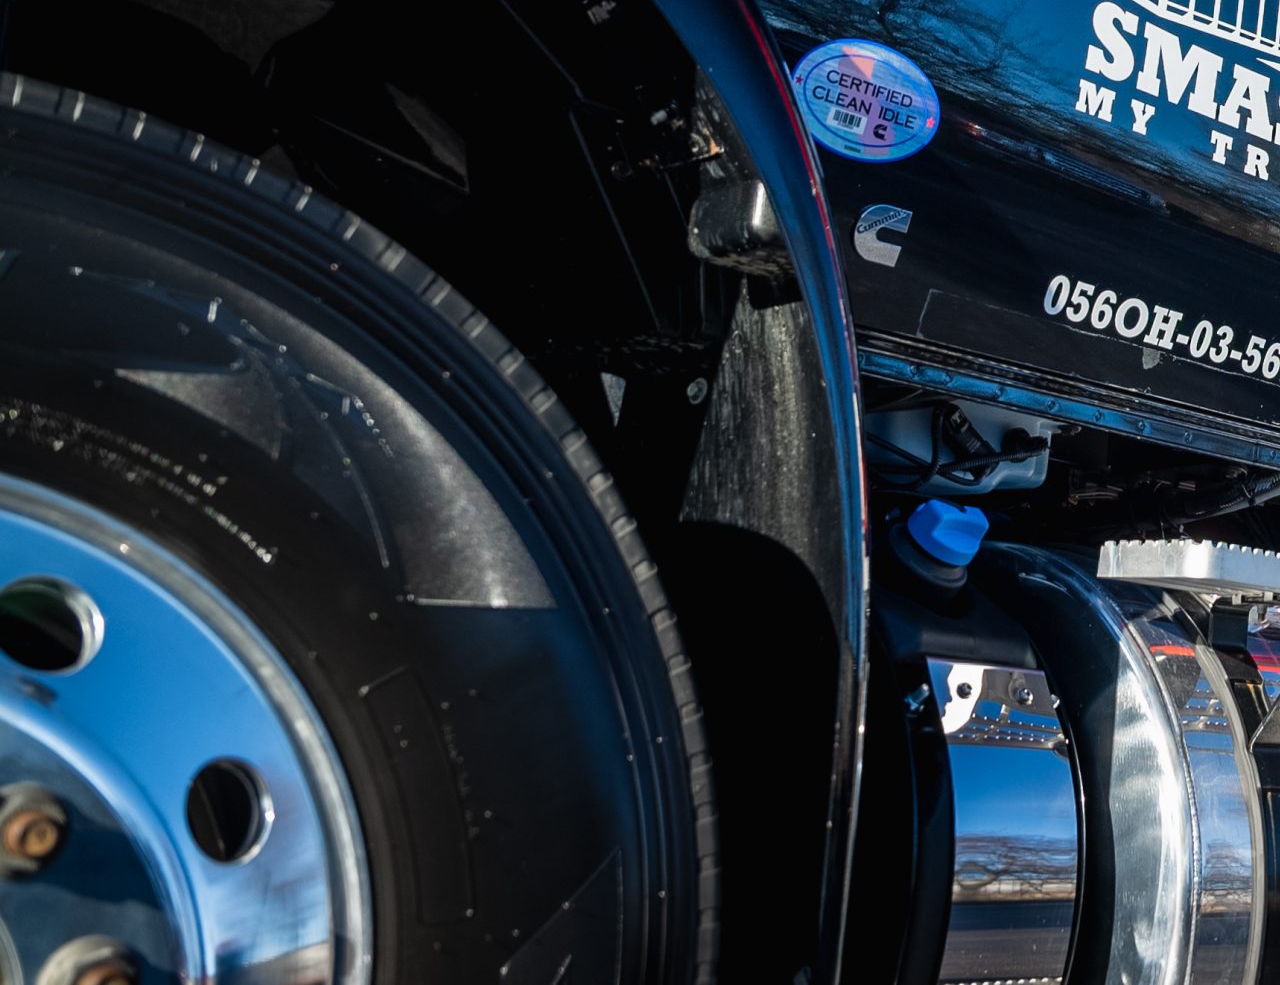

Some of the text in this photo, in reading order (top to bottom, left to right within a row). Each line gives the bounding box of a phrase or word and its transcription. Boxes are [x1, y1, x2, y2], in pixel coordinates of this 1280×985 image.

[812, 85, 917, 130] CLEAN IDLE
[826, 70, 913, 108] CERTIFIED
[1075, 78, 1155, 135] MY
[857, 210, 906, 234] Cummins
